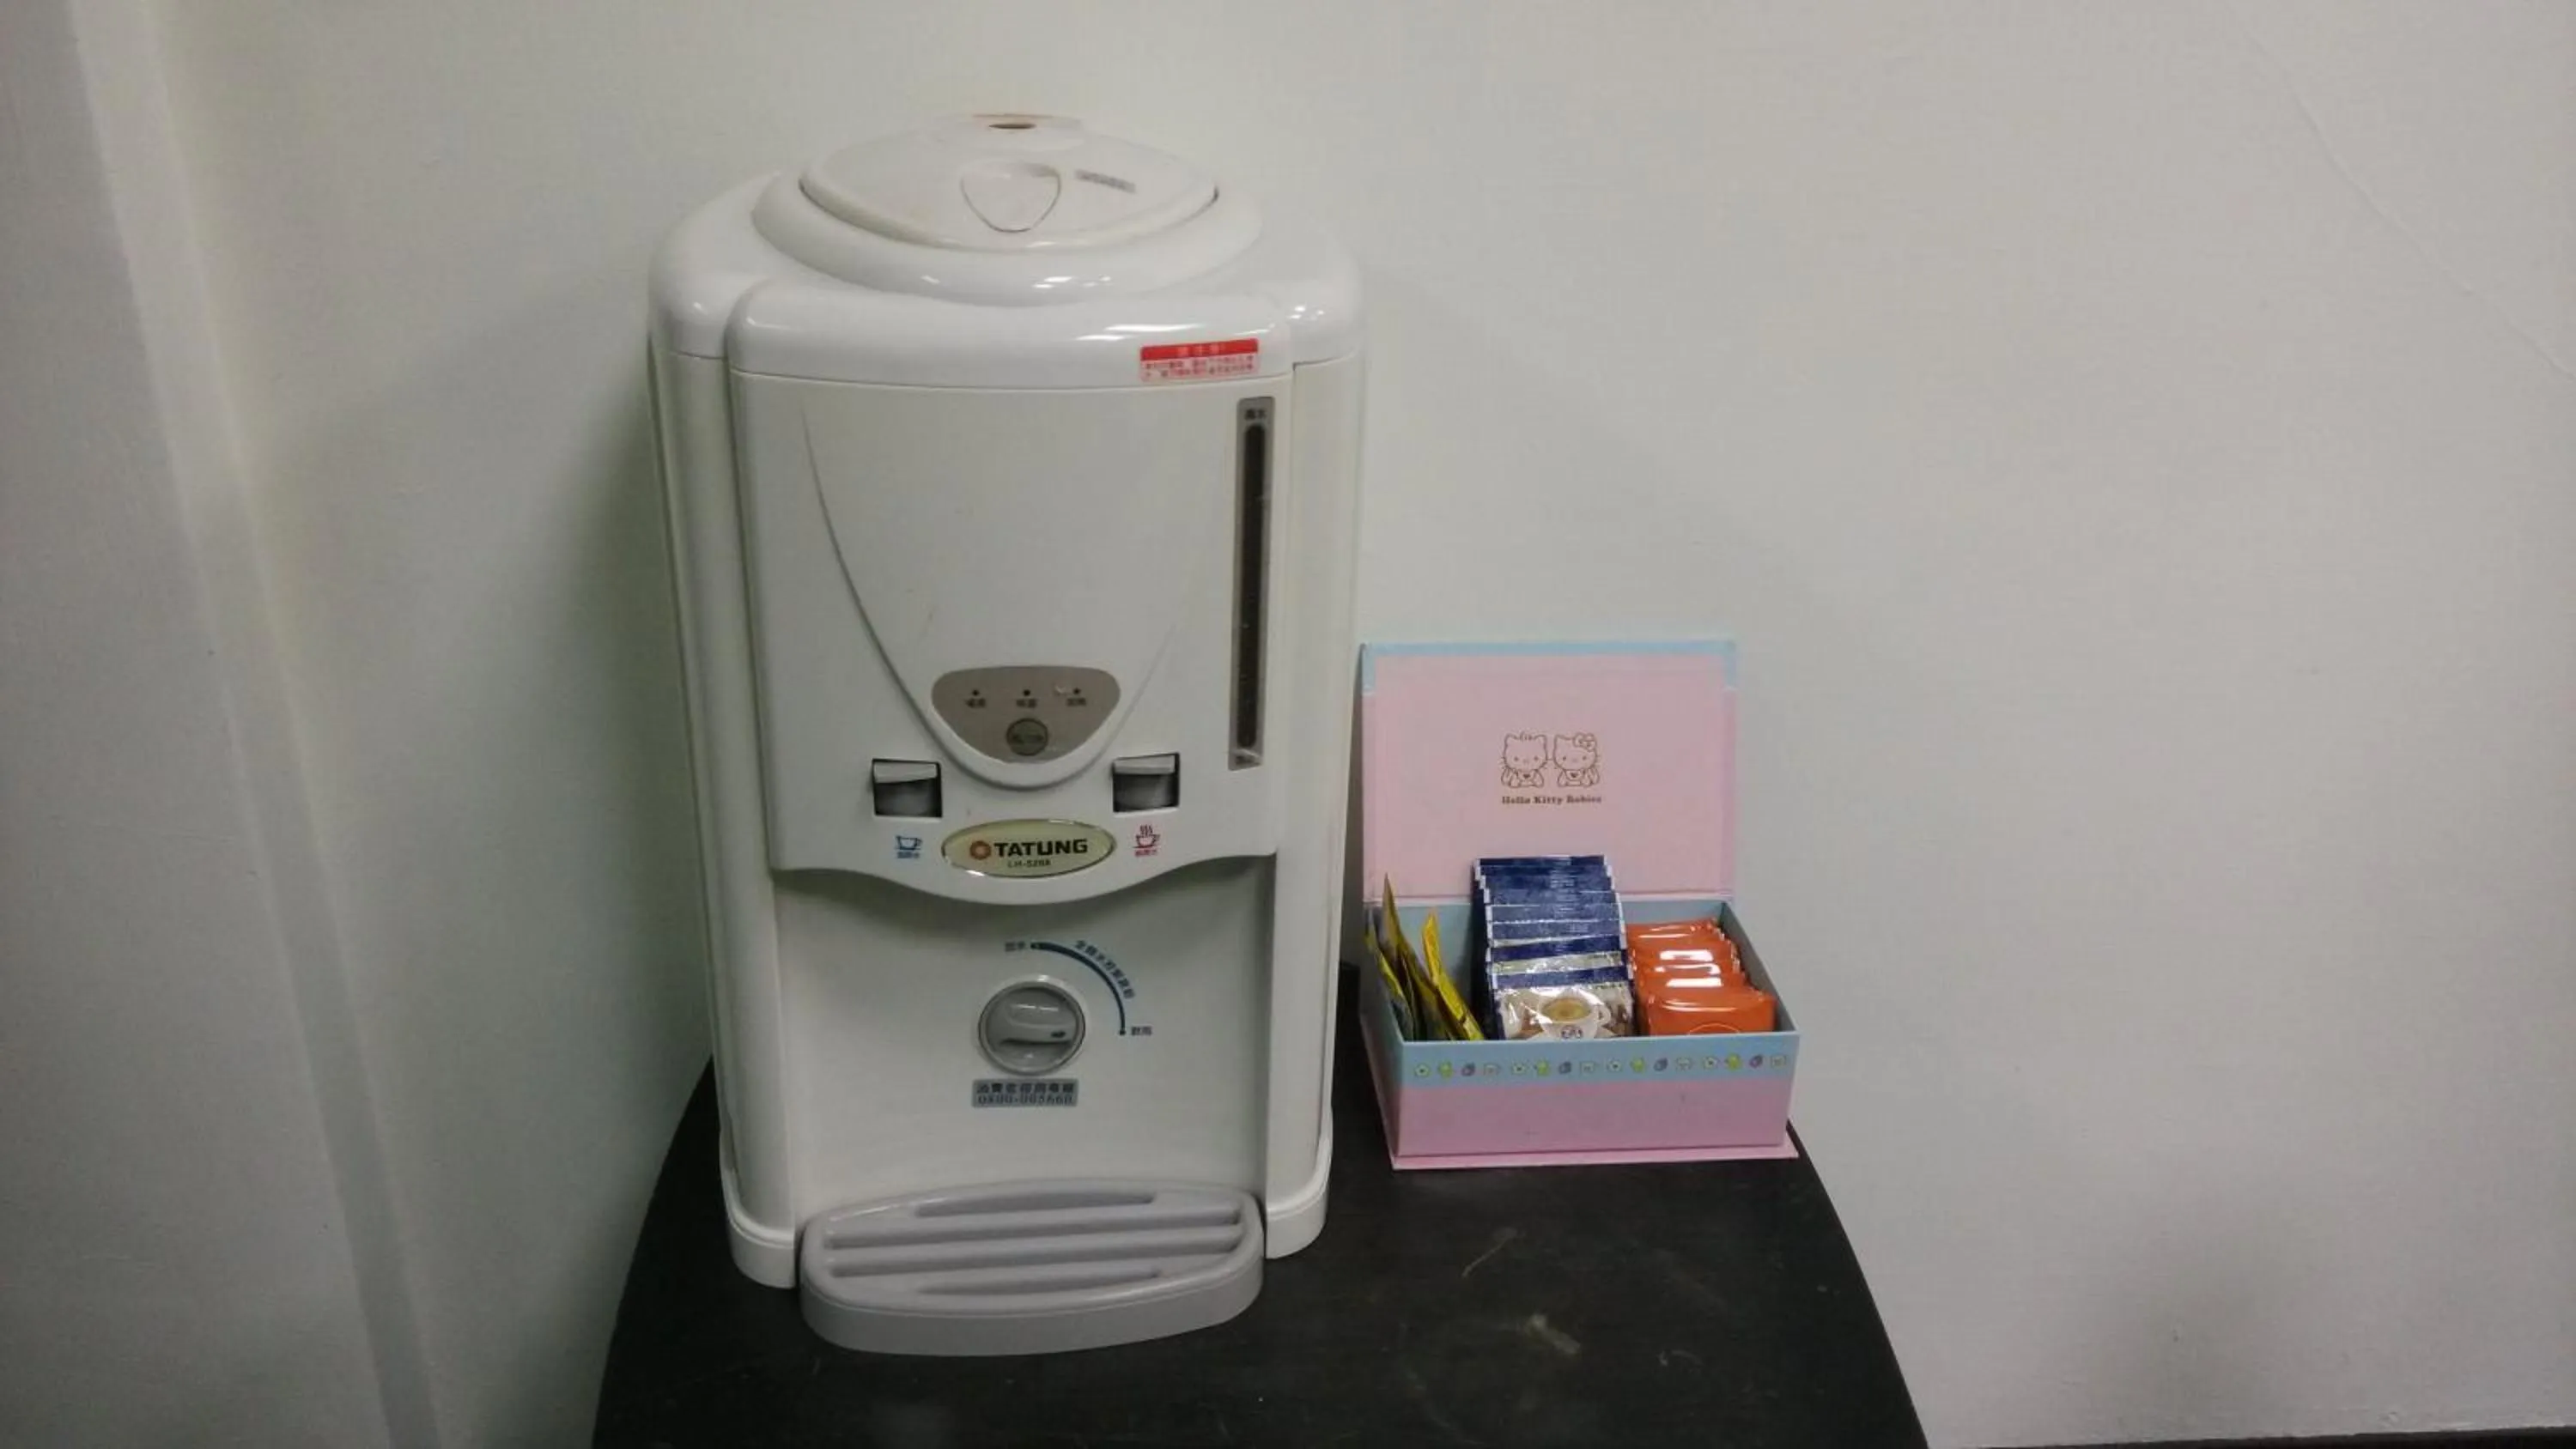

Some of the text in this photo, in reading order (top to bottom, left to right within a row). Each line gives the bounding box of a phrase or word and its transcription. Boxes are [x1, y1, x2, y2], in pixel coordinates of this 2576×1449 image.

[1502, 796, 1530, 804] Hello
[1533, 796, 1563, 806] Kitty
[993, 839, 1088, 857] TATUNG
